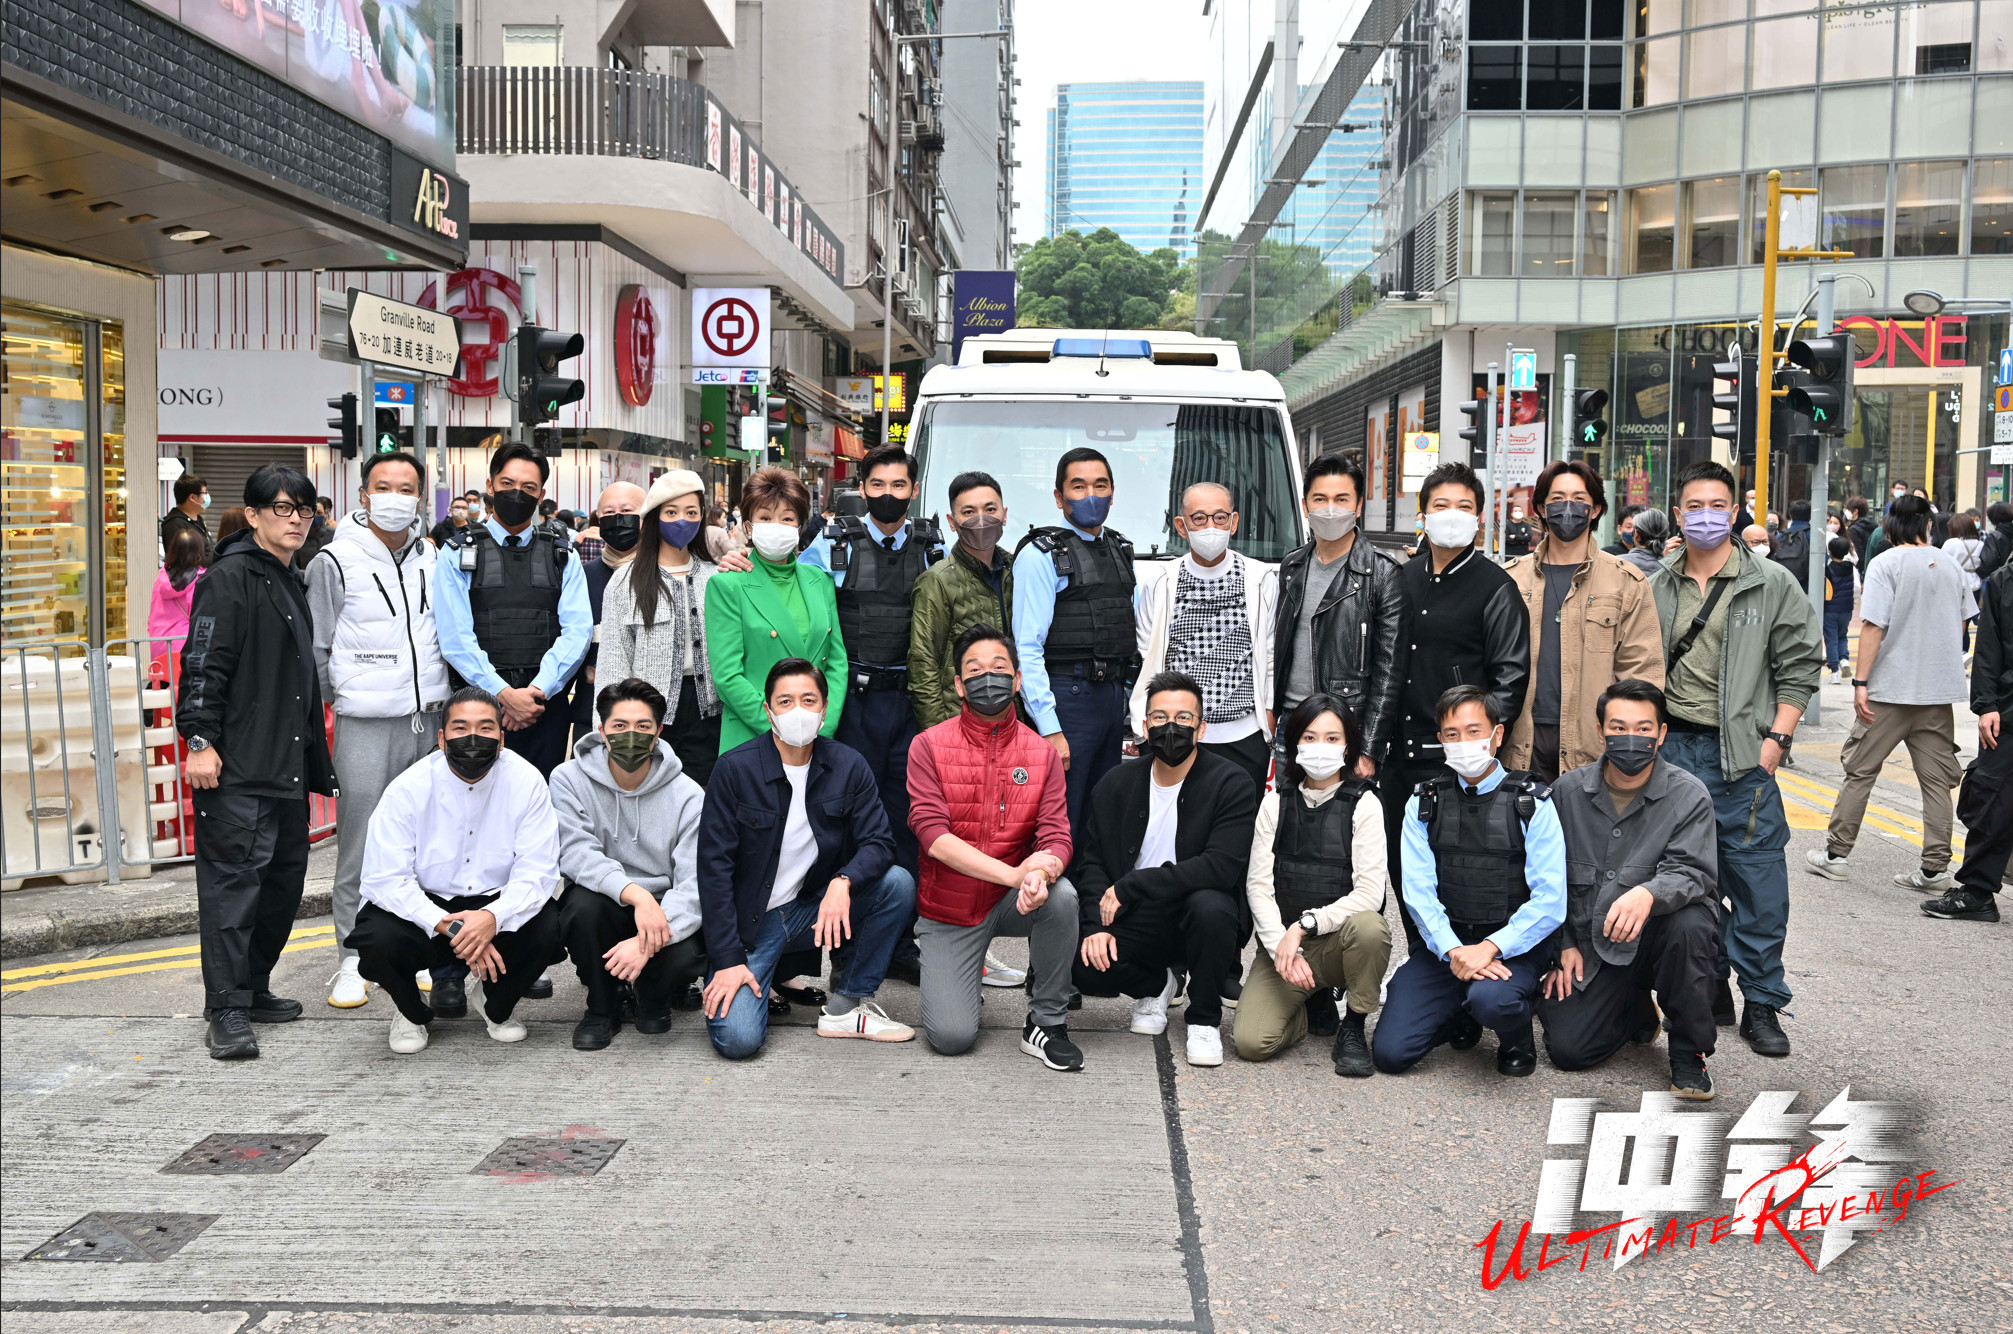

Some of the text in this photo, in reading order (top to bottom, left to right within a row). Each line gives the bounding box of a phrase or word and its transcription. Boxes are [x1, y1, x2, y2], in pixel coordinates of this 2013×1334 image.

[959, 297, 1009, 311] Albion
[380, 305, 435, 334] Granville Road
[962, 312, 1005, 327] Plaza
[382, 333, 434, 365] 加連威老道
[1833, 315, 1968, 368] ONE
[157, 386, 224, 408] ONG)
